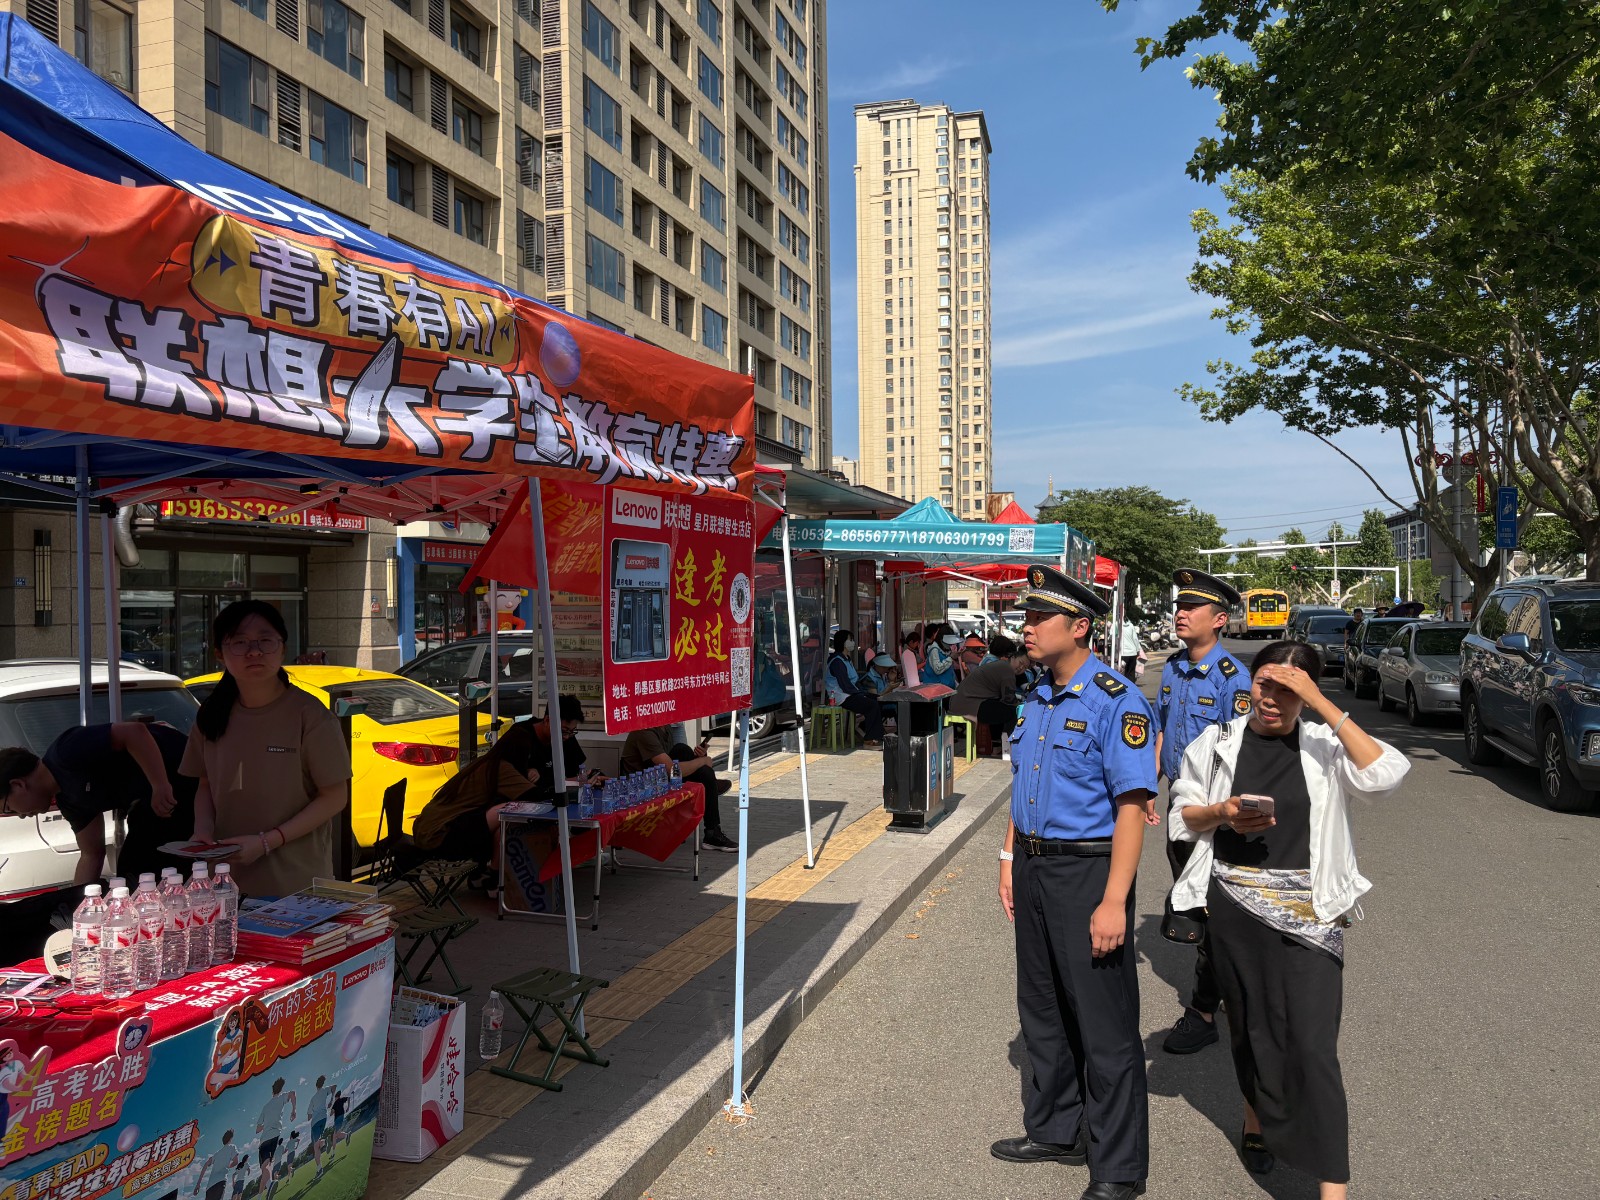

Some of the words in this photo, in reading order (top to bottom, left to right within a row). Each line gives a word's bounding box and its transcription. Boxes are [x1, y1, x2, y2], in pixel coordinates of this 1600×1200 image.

[250, 232, 497, 356] 青春有AI
[42, 281, 746, 496] 联想大学生教育特惠
[309, 513, 362, 530] 电话:154295129
[615, 497, 658, 521] Lenovo
[664, 500, 692, 530] 联想
[693, 512, 752, 539] 星月联想智生活店
[627, 556, 646, 567] Lenovo
[675, 547, 728, 607] 逢考
[674, 613, 728, 663] 必过
[185, 981, 227, 992] 3A
[185, 975, 276, 1008] 新时代
[267, 976, 334, 1029] 你的实力
[344, 968, 368, 986] Lenovo
[244, 1000, 333, 1074] 无人能敌
[29, 1051, 144, 1114] 高考必胜
[447, 1036, 461, 1116] 娃哈哈
[0, 1091, 120, 1155] 金榜题名
[13, 1148, 96, 1200] 青春有AI
[41, 1121, 196, 1200] 学生教育特惠
